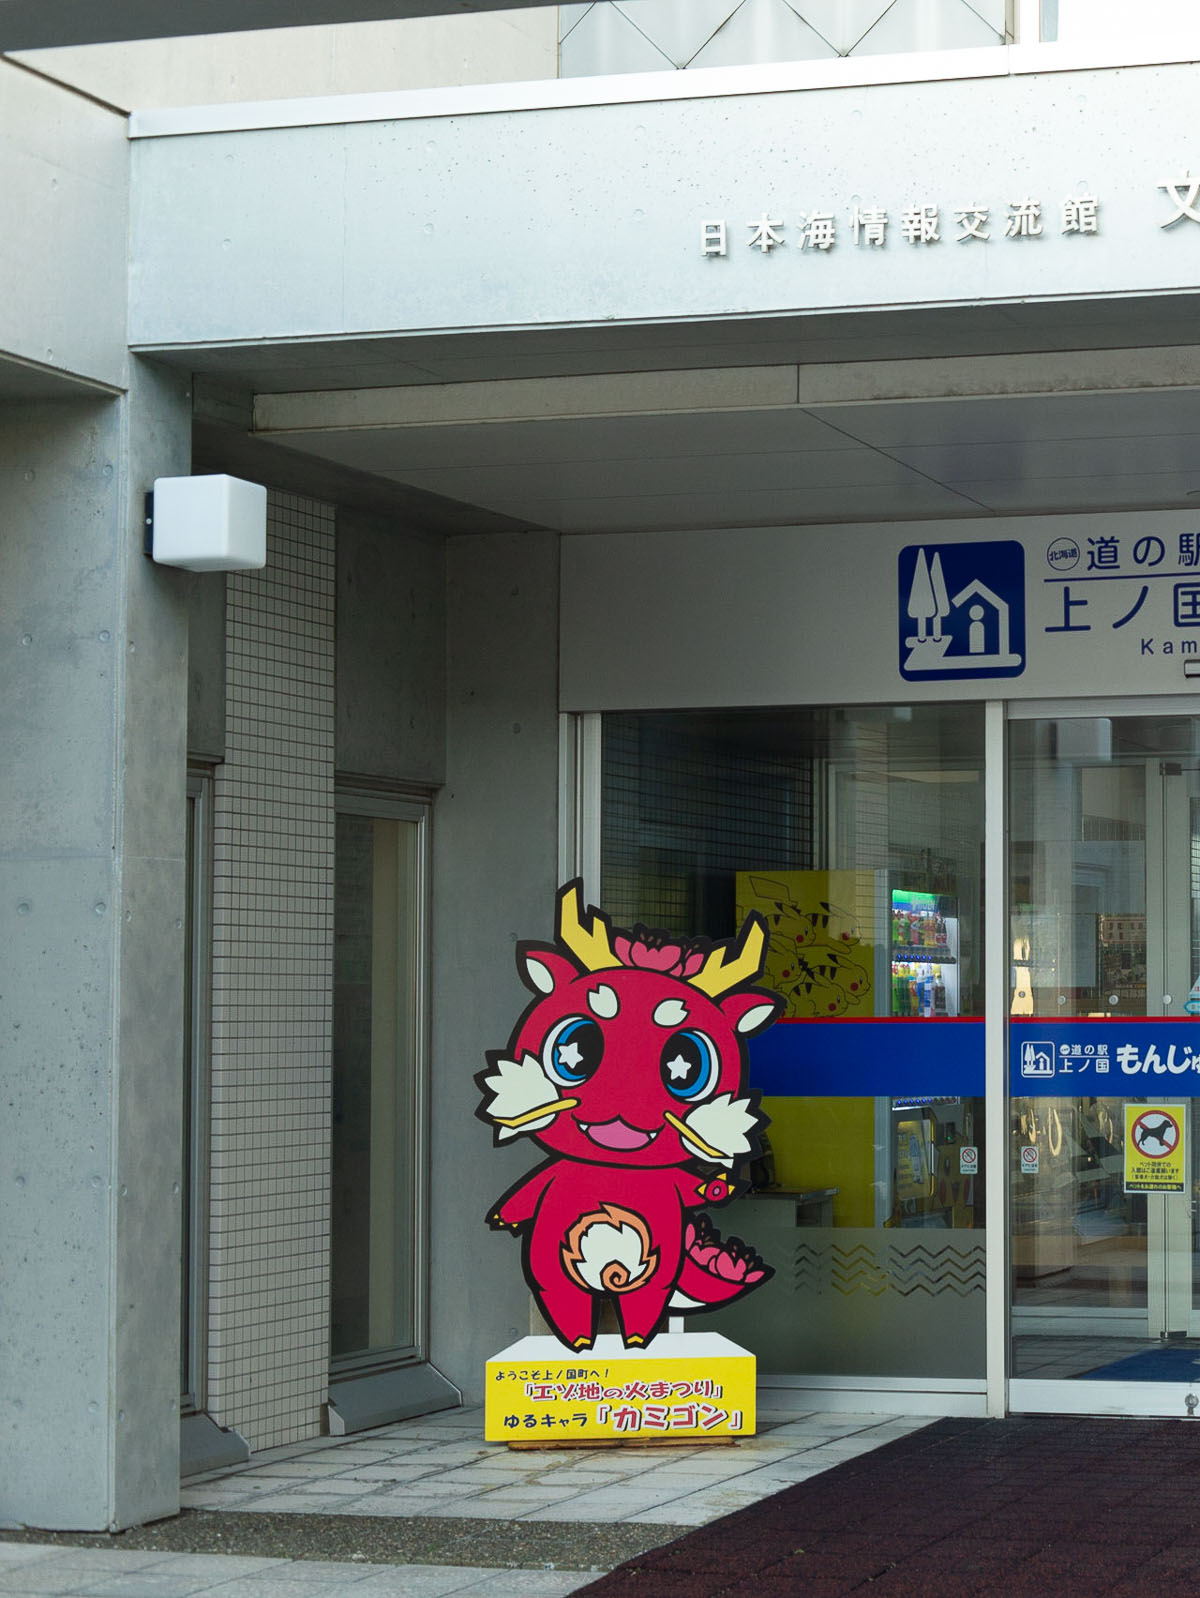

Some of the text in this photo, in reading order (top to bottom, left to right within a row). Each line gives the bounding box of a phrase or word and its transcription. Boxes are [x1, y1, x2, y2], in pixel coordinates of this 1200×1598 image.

[700, 191, 1100, 258] 日本海情報交流館
[1071, 1044, 1109, 1056] 道の駅
[1058, 1058, 1110, 1074] 上ノ国
[504, 1412, 588, 1429] ゆるキャラ
